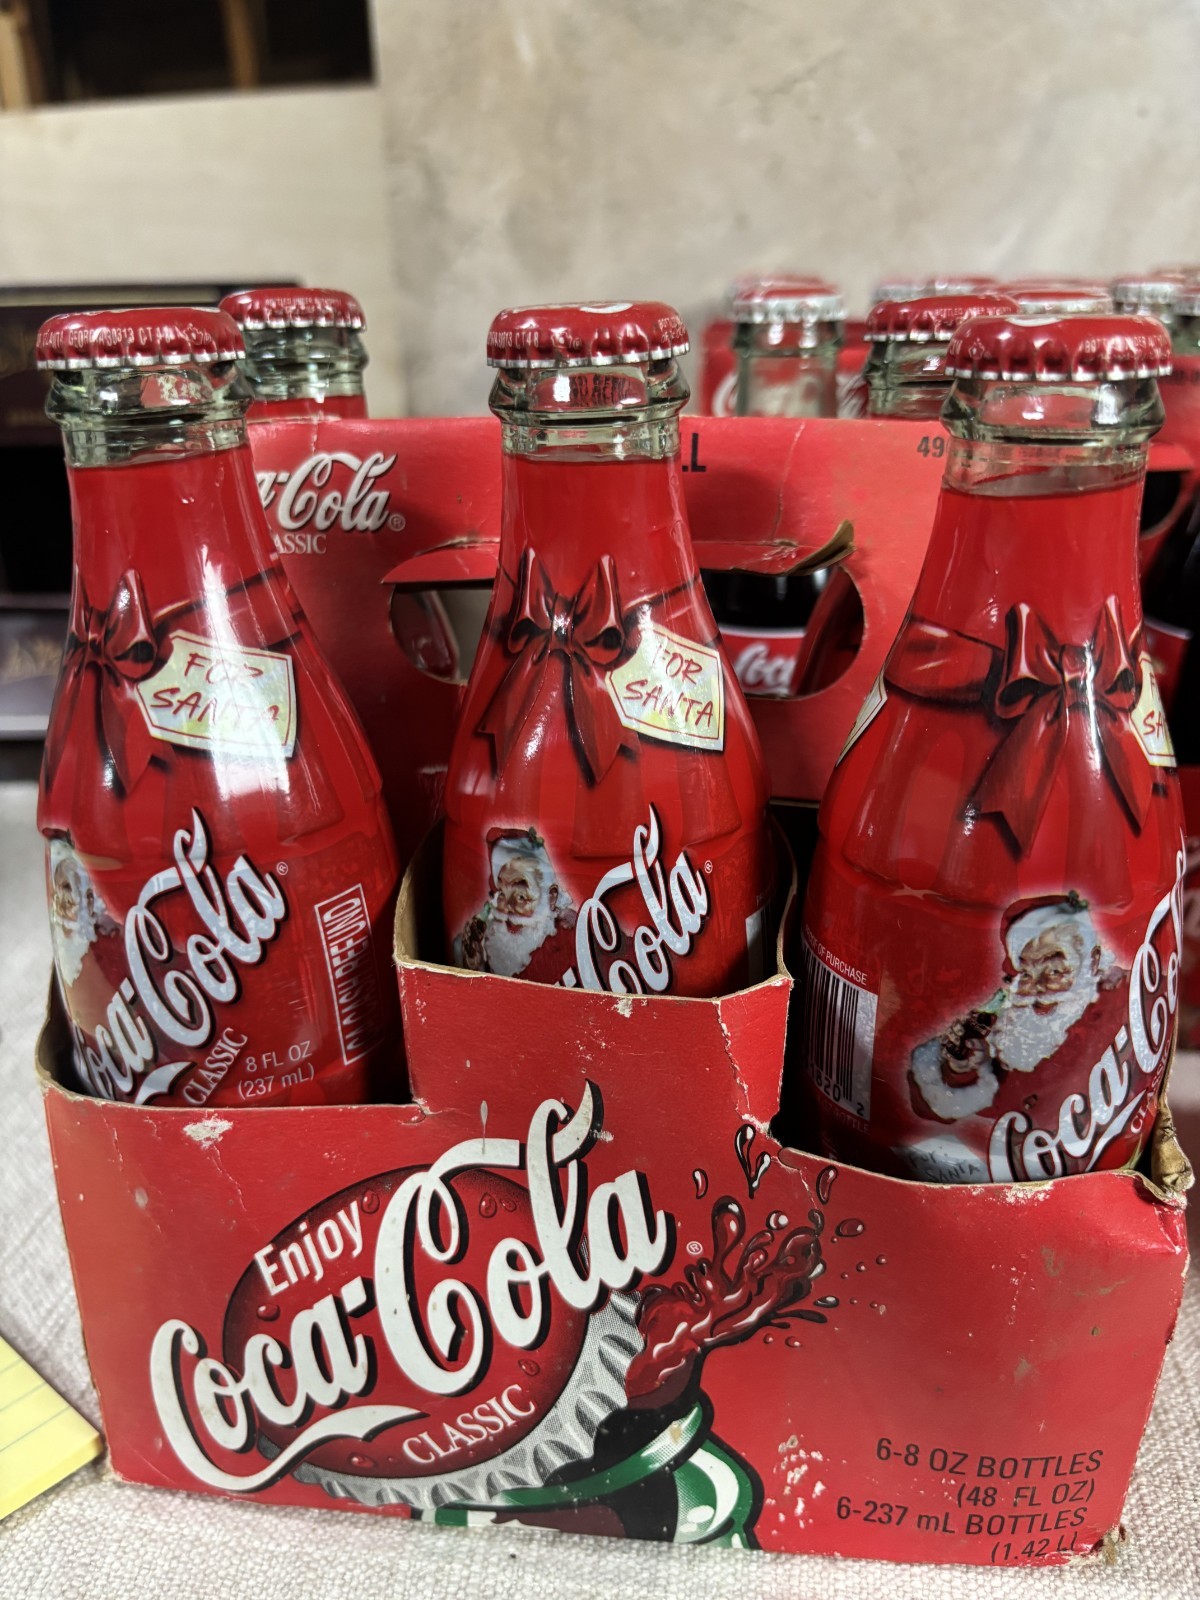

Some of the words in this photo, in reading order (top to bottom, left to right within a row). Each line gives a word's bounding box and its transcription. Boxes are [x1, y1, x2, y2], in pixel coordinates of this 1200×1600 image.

[256, 452, 397, 531] a-Cola
[273, 534, 326, 554] ASSIC
[624, 679, 714, 728] SANTA
[323, 897, 374, 979] REFUND
[818, 943, 826, 957] OF
[825, 950, 868, 986] PURCHASE
[182, 1028, 248, 1104] CLASSIC
[246, 1055, 257, 1072] 8
[263, 1052, 283, 1068] FL
[290, 1040, 312, 1061] OZ
[238, 1074, 274, 1100] (237
[282, 1063, 314, 1087] mL)
[254, 1200, 363, 1296] Enjoy
[150, 1079, 670, 1491] Coca-Cola
[402, 1384, 537, 1467] CLASSIC
[876, 1437, 919, 1466] 6-8
[929, 1448, 968, 1476] OZ
[977, 1449, 1104, 1479] BOTTLES
[957, 1483, 997, 1508] (48
[1013, 1486, 1041, 1507] FL
[1052, 1478, 1095, 1504] OZ)
[836, 1495, 908, 1526] 6-237
[917, 1511, 955, 1534] mL
[965, 1507, 1088, 1536] BOTTLES
[991, 1538, 1050, 1563] (1.42
